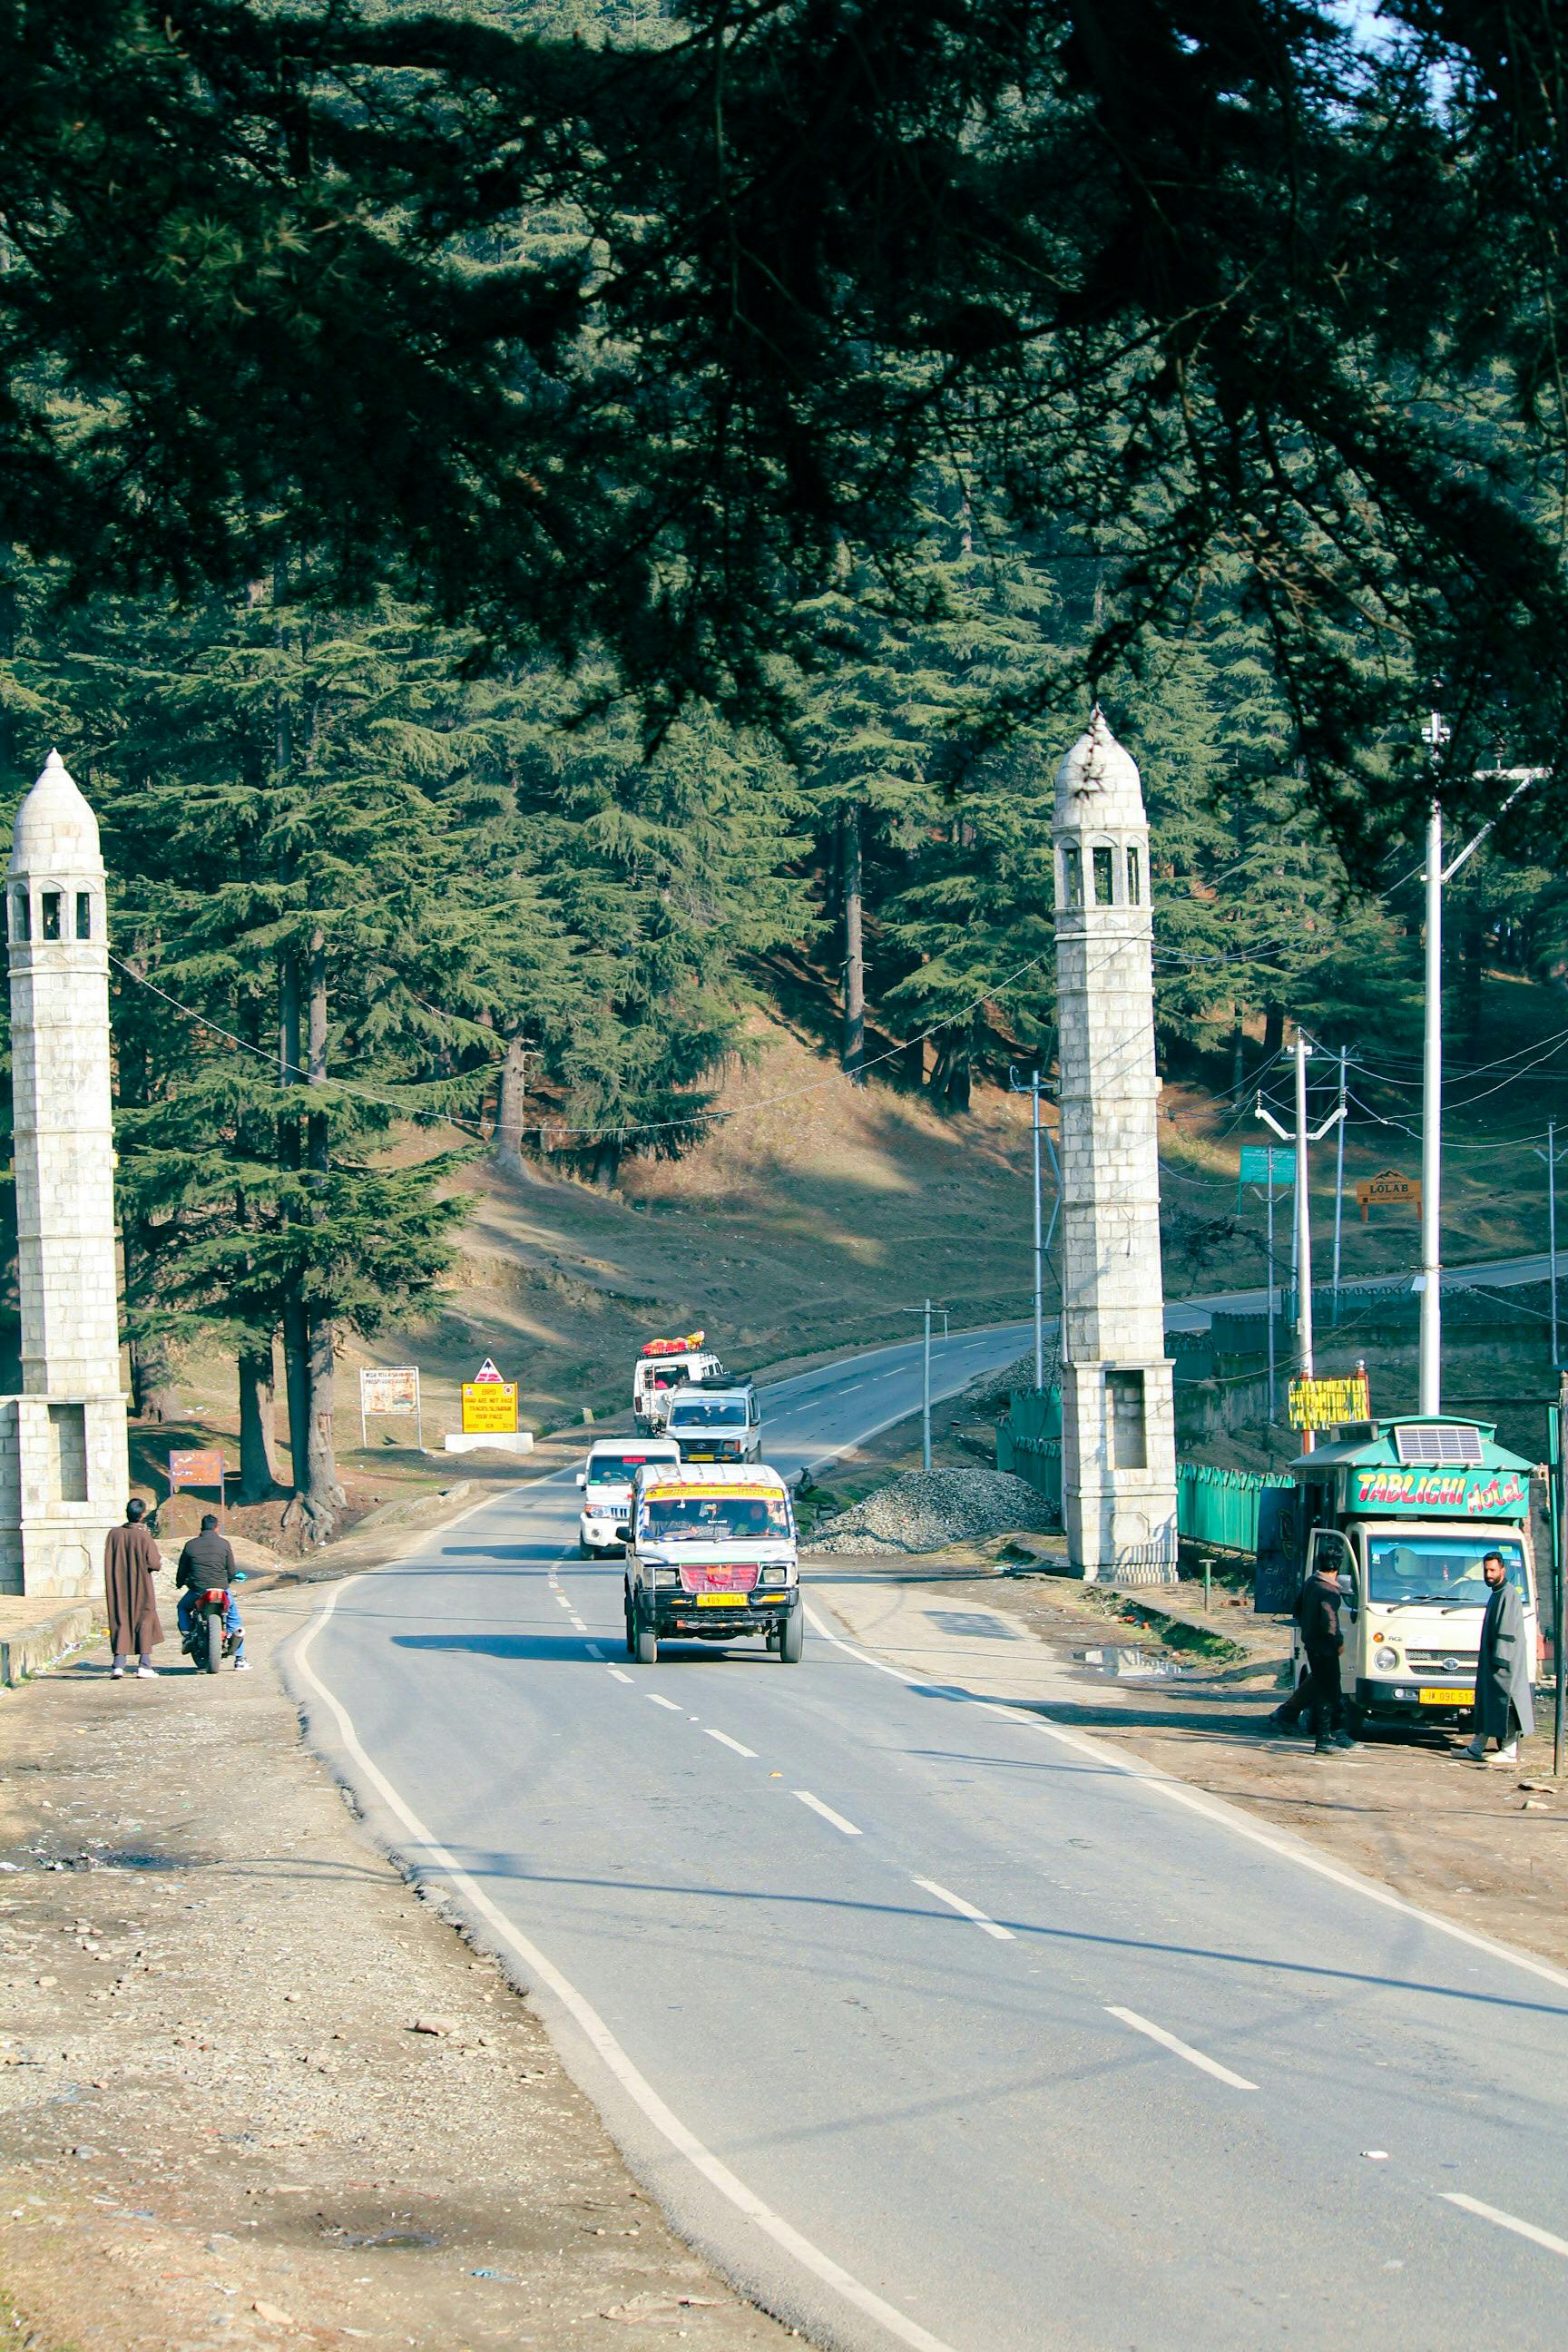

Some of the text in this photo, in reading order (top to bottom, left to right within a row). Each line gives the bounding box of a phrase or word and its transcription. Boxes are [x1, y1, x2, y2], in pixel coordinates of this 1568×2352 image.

[1370, 1184, 1408, 1193] LOLAB
[1357, 1473, 1525, 1514] TABLIGHI Hotel
[1426, 1690, 1436, 1700] JK
[1439, 1691, 1455, 1701] 09C
